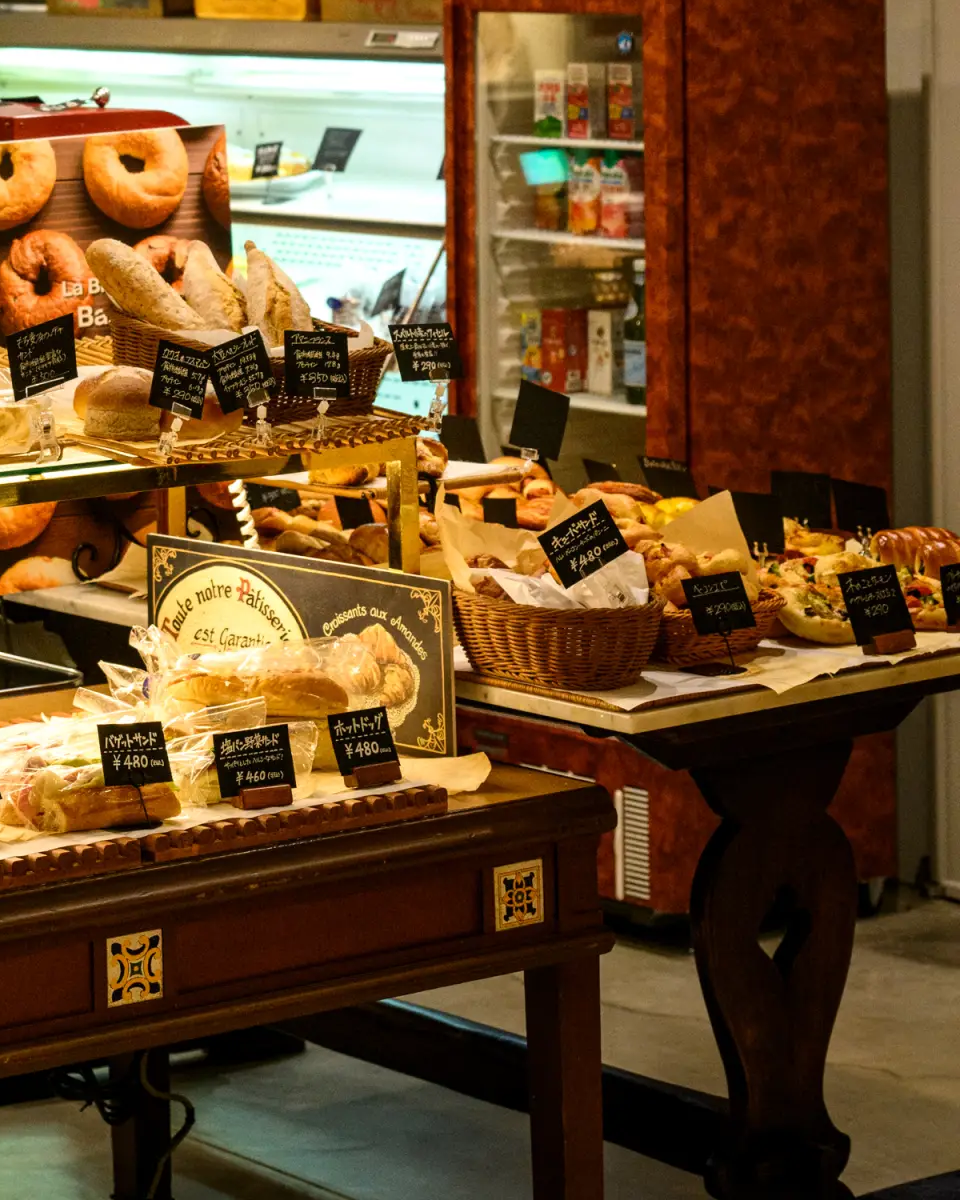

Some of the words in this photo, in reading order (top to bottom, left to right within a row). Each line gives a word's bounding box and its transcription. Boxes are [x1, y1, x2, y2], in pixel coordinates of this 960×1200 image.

[61, 280, 83, 297] La
[77, 305, 111, 328] Ba
[160, 599, 194, 643] Toute
[195, 578, 233, 605] notre
[193, 628, 216, 644] est
[322, 603, 368, 636] Croissants
[369, 606, 388, 621] aux
[390, 616, 428, 661] Amandes
[333, 711, 384, 737] ホットドッグ
[104, 732, 158, 749] バゲットサンド
